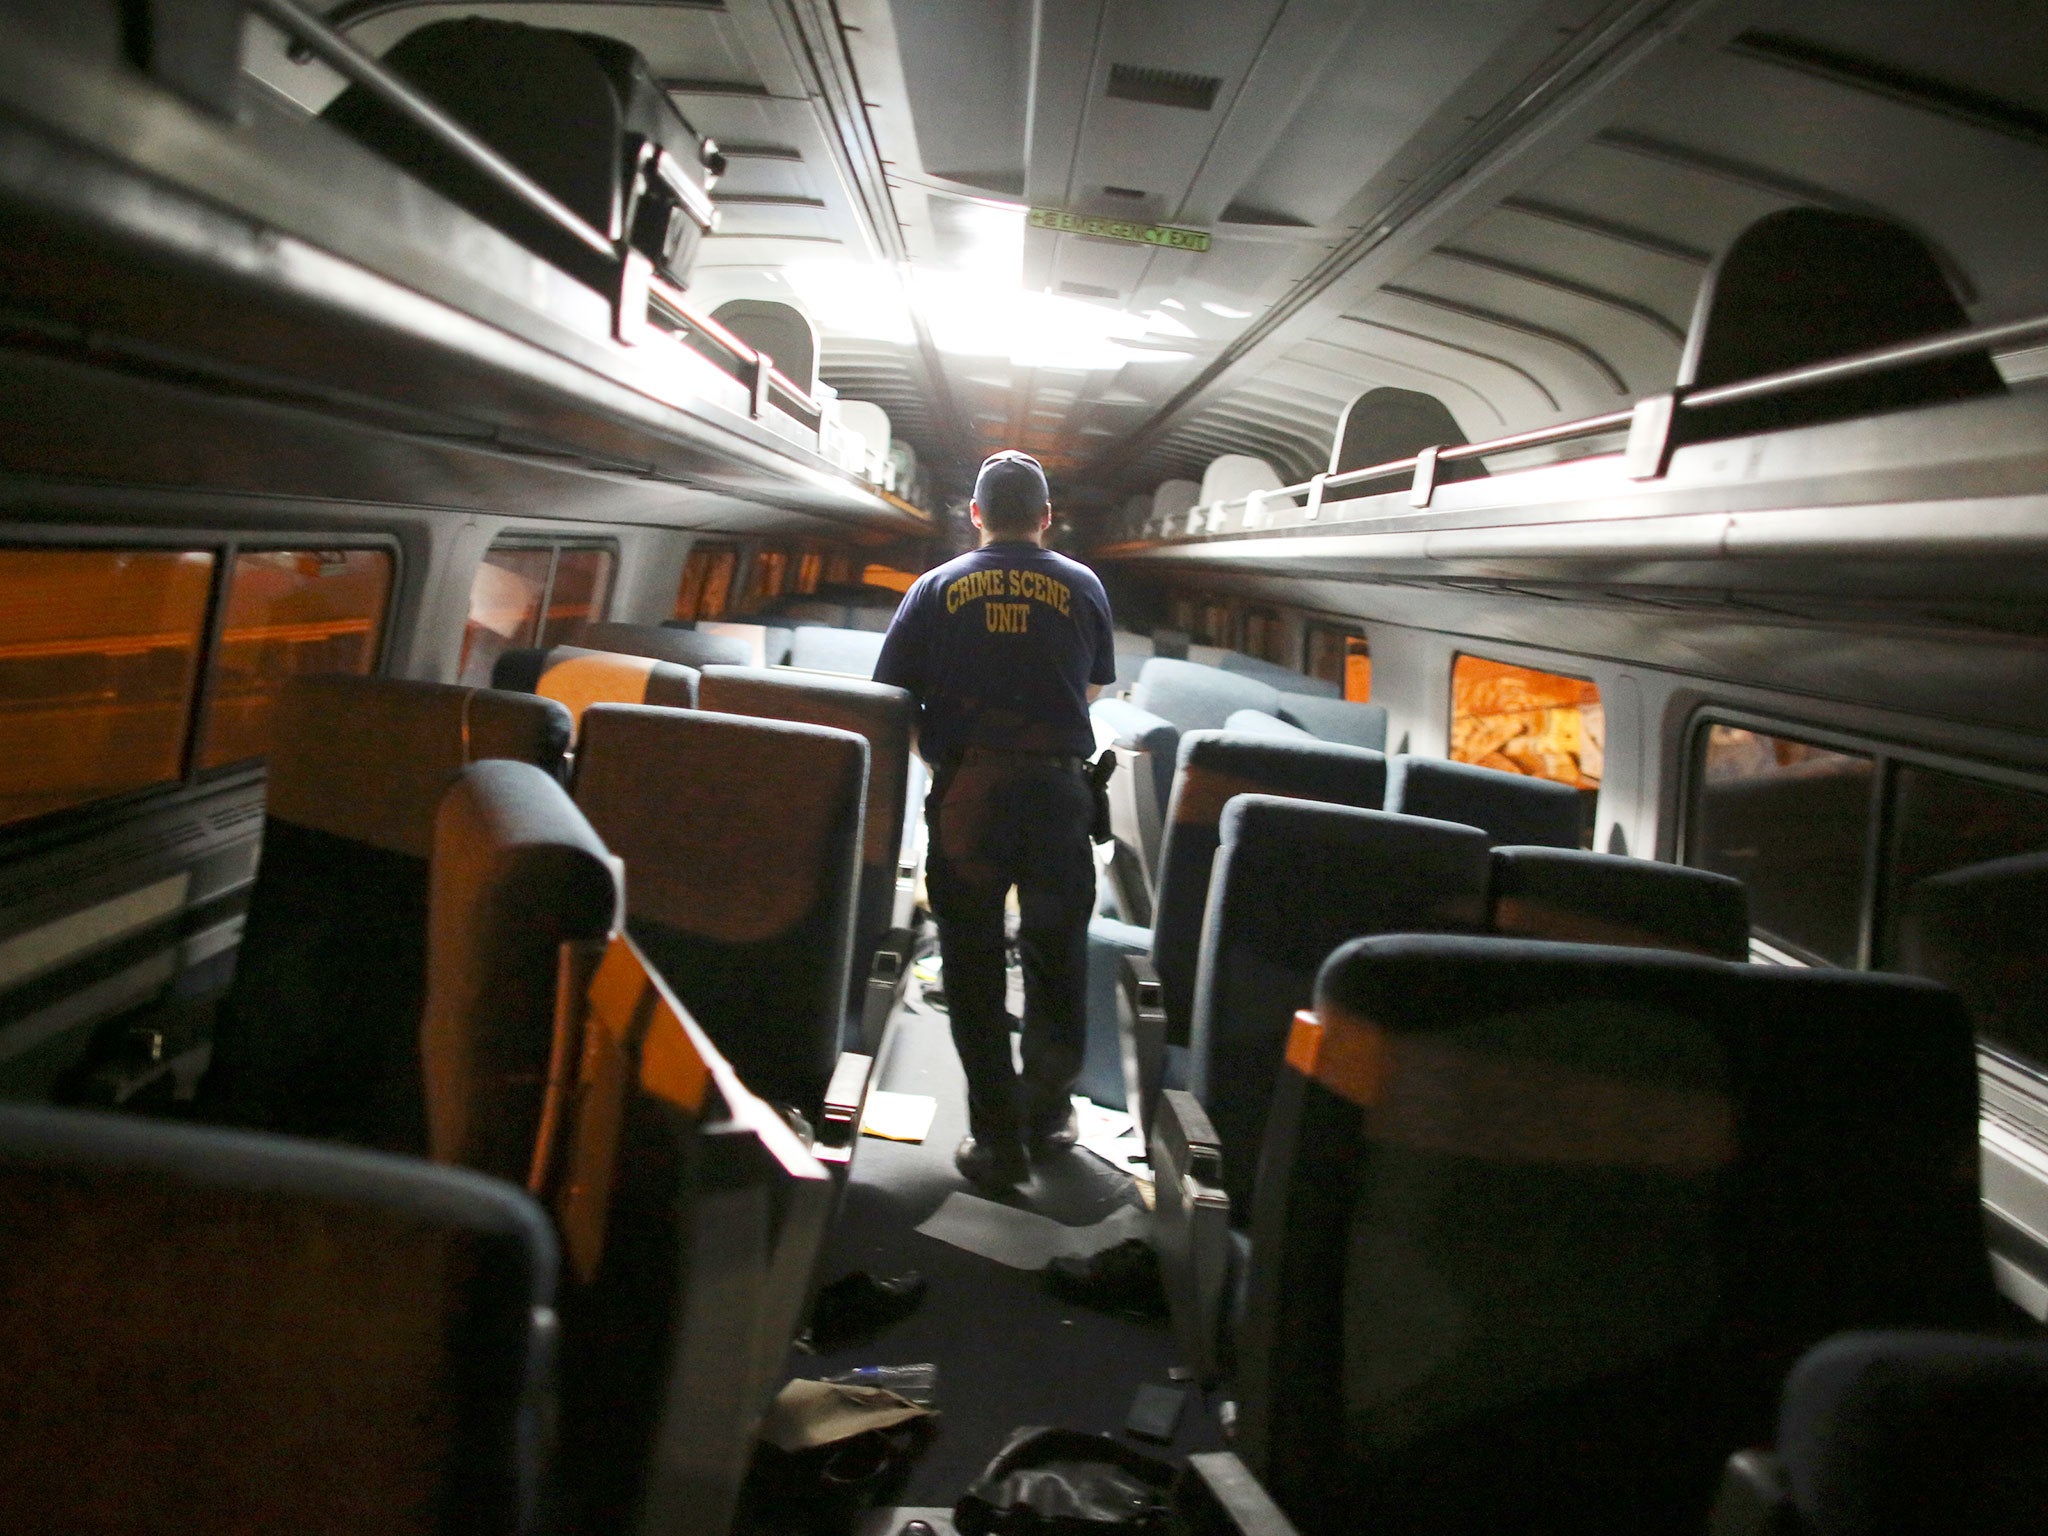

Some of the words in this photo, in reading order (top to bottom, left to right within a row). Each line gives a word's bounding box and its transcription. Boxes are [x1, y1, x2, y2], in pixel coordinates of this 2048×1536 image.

[1063, 214, 1163, 243] EMERGENCY
[1169, 230, 1206, 249] EXIT
[946, 569, 1005, 614] CRIME
[1009, 569, 1071, 617] SCENE
[985, 602, 1030, 633] UNIT
